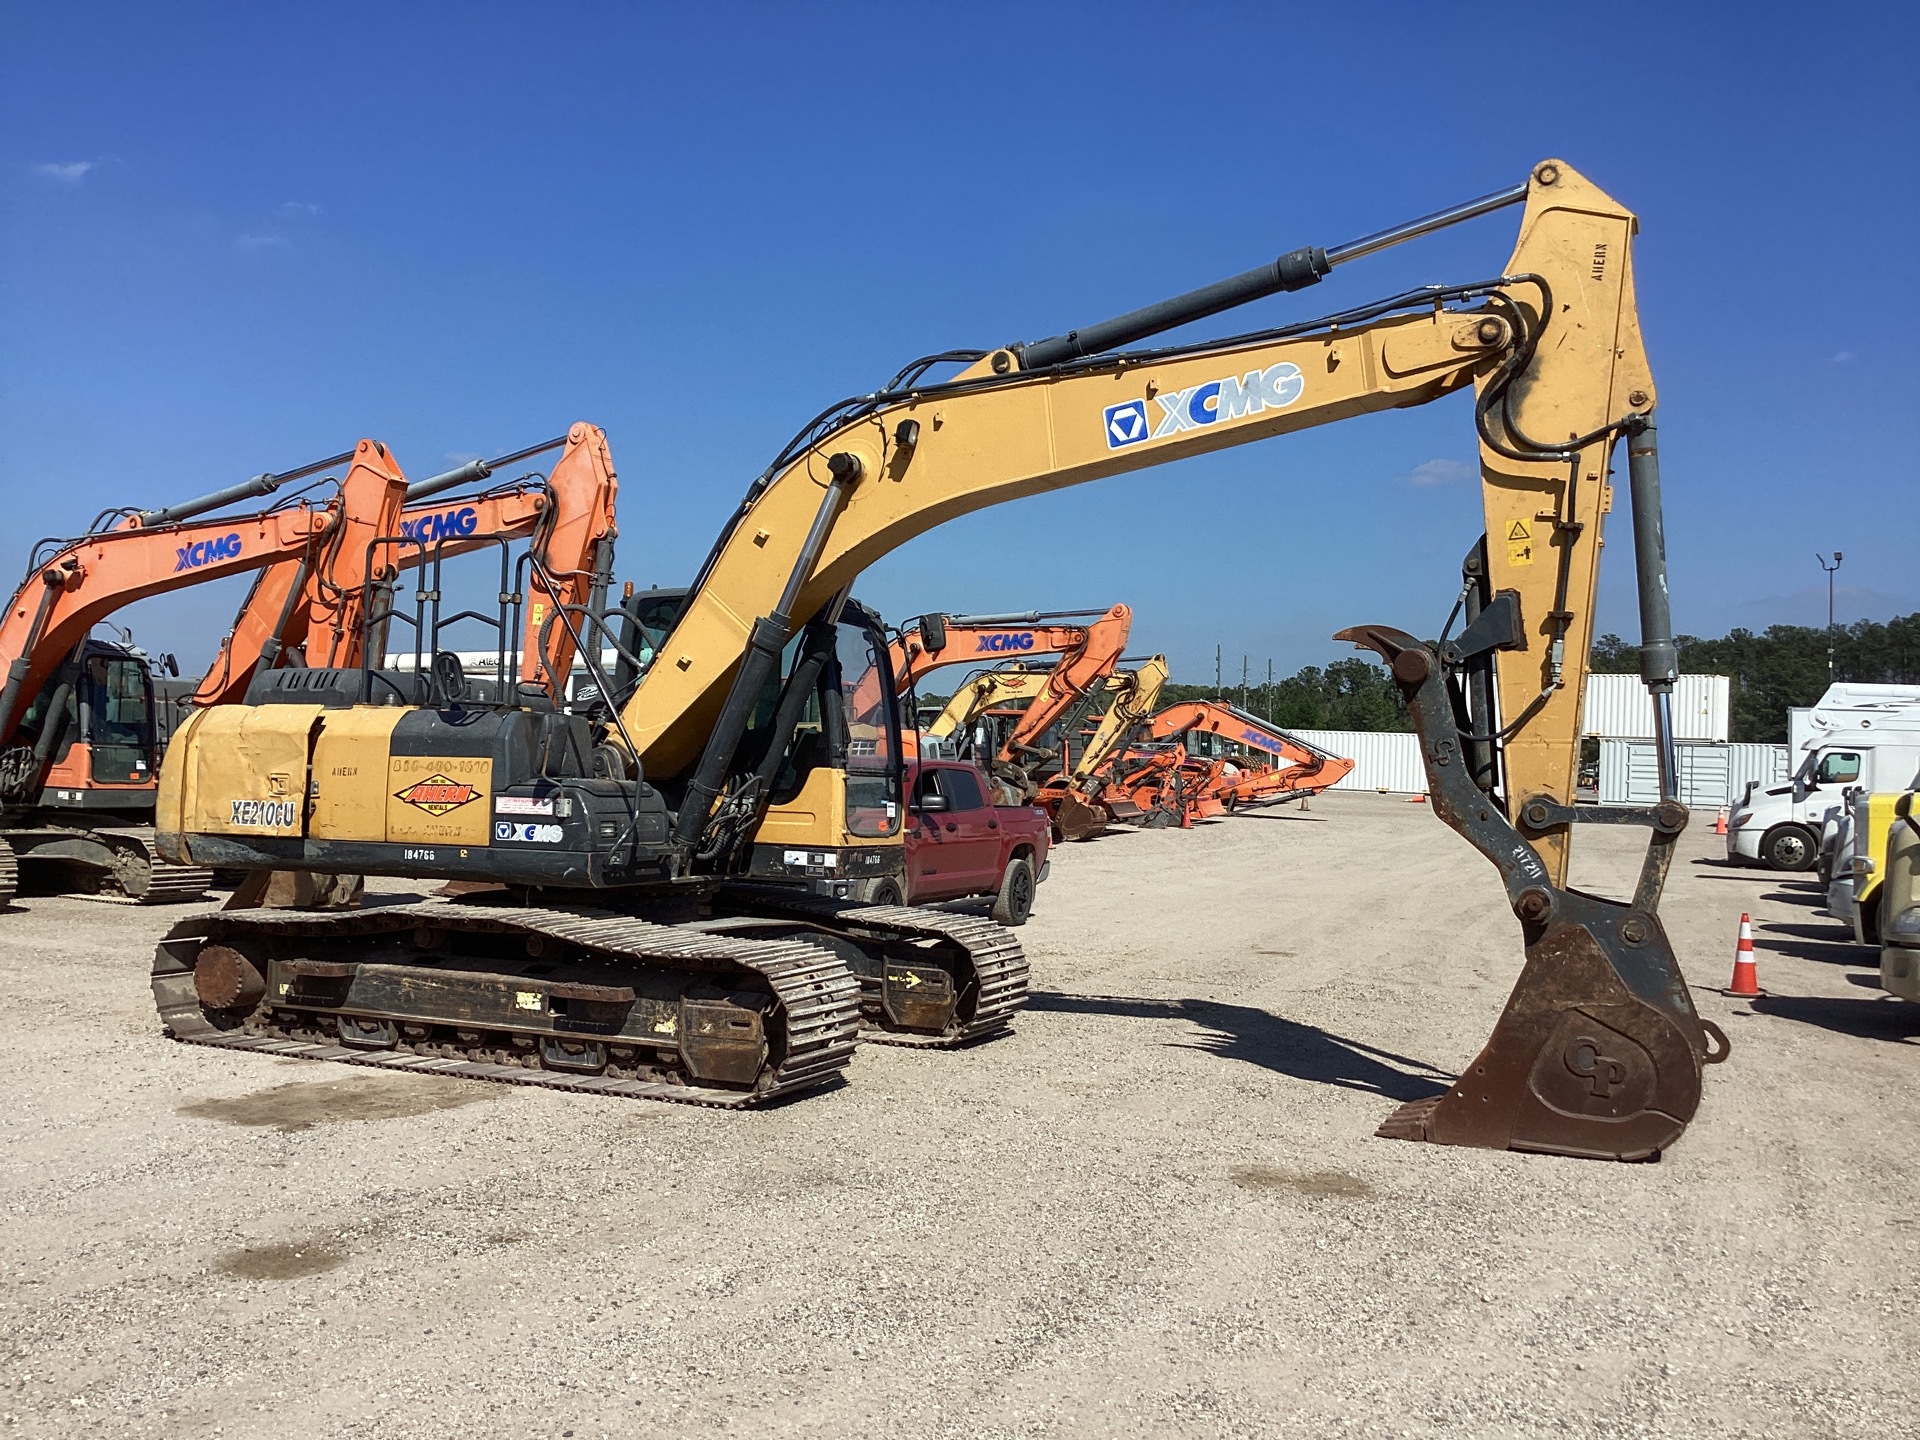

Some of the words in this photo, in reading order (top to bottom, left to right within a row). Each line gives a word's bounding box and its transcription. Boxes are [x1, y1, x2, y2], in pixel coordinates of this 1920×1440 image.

[1591, 244, 1607, 281] AHERN
[1151, 362, 1305, 439] XCMG
[398, 507, 478, 548] XCMG
[174, 533, 242, 572] XCMG
[976, 633, 1034, 652] XCMG
[1240, 729, 1283, 752] XCMG
[404, 785, 472, 802] AHERN
[230, 800, 296, 828] XE210CU
[511, 823, 563, 843] XCMG
[404, 849, 435, 860] 184766
